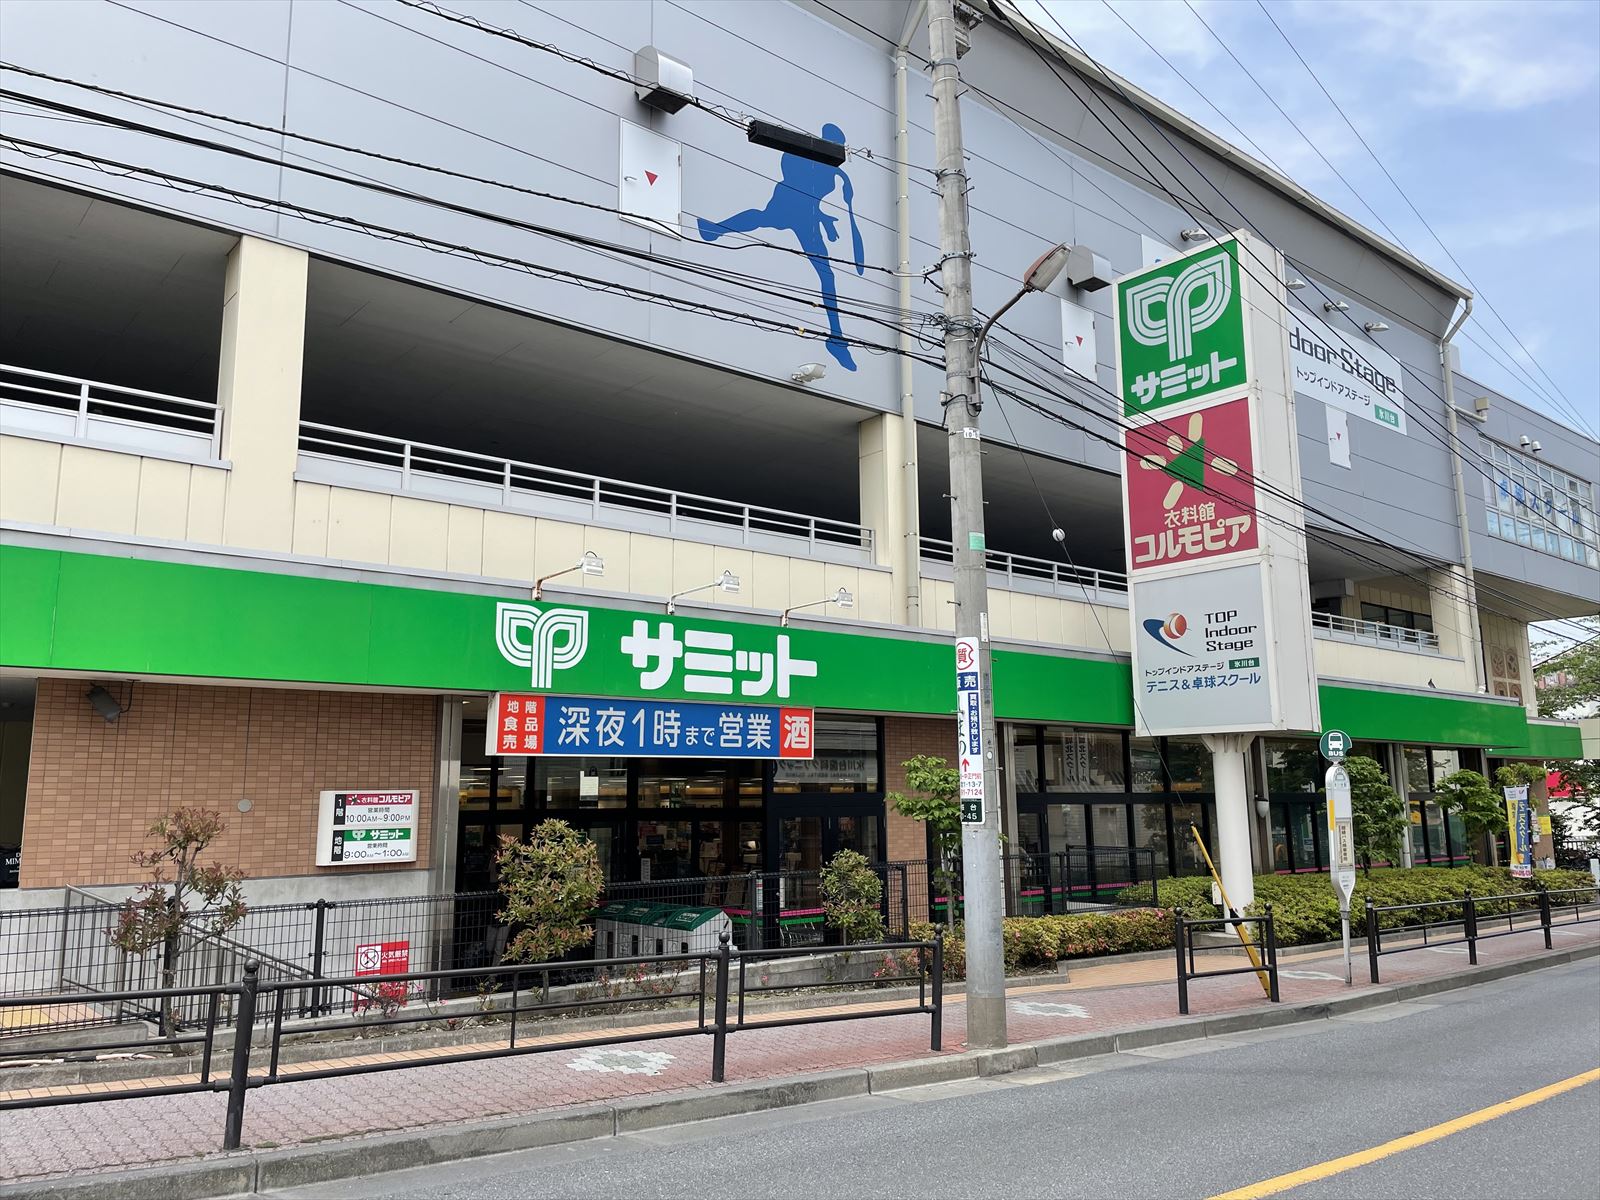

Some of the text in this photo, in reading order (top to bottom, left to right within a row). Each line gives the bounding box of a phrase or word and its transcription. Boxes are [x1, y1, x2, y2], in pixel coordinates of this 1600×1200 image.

[1131, 351, 1238, 404] サミット
[1340, 347, 1396, 395] Stage
[1296, 366, 1371, 406] トップインドアステージ
[1164, 502, 1216, 528] 衣料館
[1134, 514, 1252, 563] コルモピア
[1205, 610, 1238, 624] TOP
[1205, 625, 1257, 638] Indoor
[1206, 639, 1253, 652] Stage
[620, 619, 818, 699] サミット
[958, 648, 967, 663] 質
[1145, 659, 1255, 677] トップインドアステージ 氷川台
[507, 700, 537, 714] 地階
[503, 716, 538, 732] 食品
[557, 705, 810, 750] 深夜1時まで営業 酒
[502, 734, 537, 750] 売場
[370, 829, 404, 840] サミット
[333, 836, 343, 855] 地階
[382, 949, 408, 959] 火気厳禁
